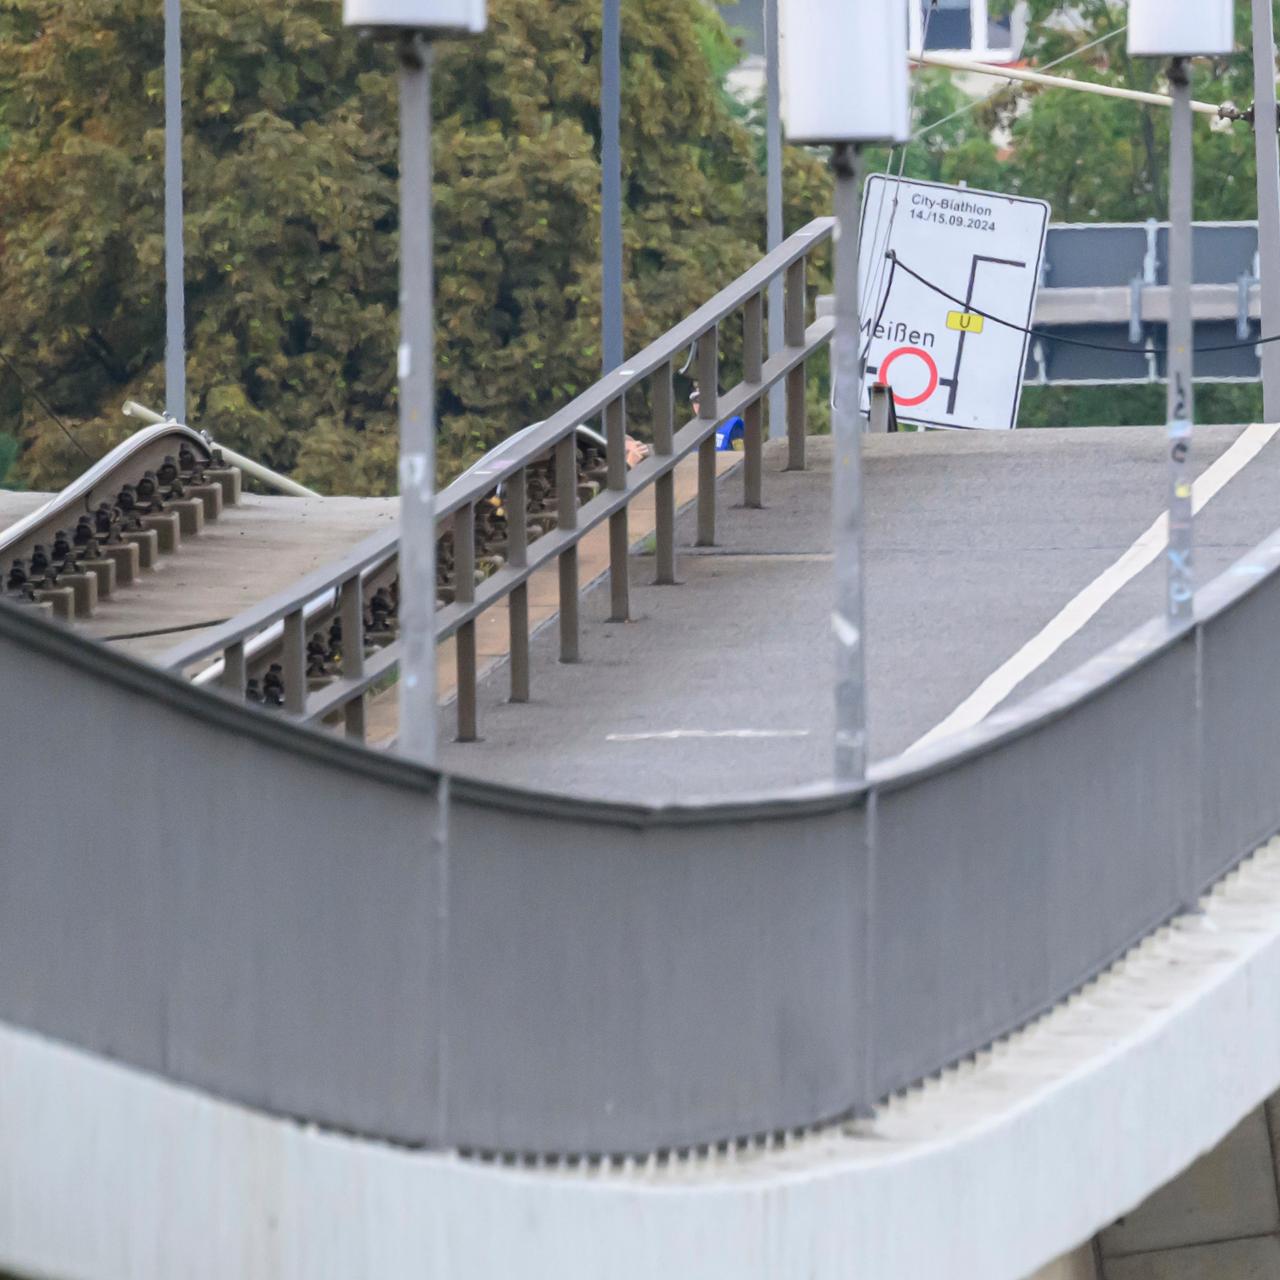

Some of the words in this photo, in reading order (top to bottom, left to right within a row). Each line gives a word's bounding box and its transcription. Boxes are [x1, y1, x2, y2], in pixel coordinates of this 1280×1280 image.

[912, 193, 992, 216] City-Biathlon
[910, 209, 996, 231] 14./15.09.2024
[959, 315, 971, 329] U
